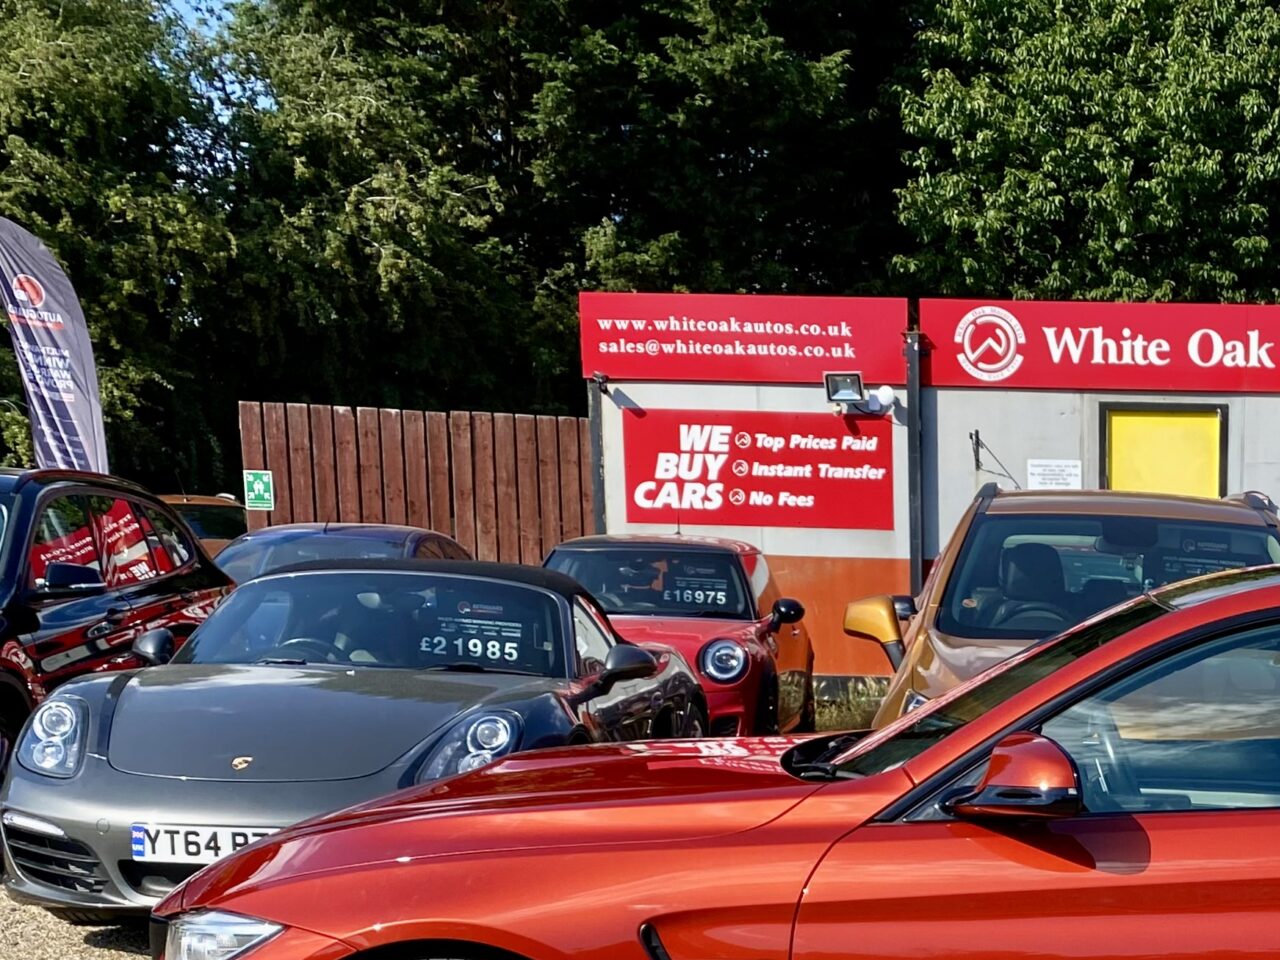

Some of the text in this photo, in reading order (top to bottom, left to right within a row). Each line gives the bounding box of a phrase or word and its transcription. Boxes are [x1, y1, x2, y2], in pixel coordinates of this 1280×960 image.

[597, 316, 852, 337] www.whiteoakautos.co.uk
[599, 339, 856, 358] sales@whiteoakautos.co.uk
[1042, 326, 1171, 366] White
[1188, 328, 1275, 369] Oak
[679, 424, 732, 453] WE
[754, 434, 878, 452] Top Prices Paid
[654, 453, 728, 481] BUY
[751, 462, 886, 480] Instant Transfer
[634, 481, 724, 510] CARS
[749, 491, 814, 507] No Fees
[664, 590, 727, 605] £16975
[420, 636, 518, 661] £21985
[145, 829, 221, 857] YT64
